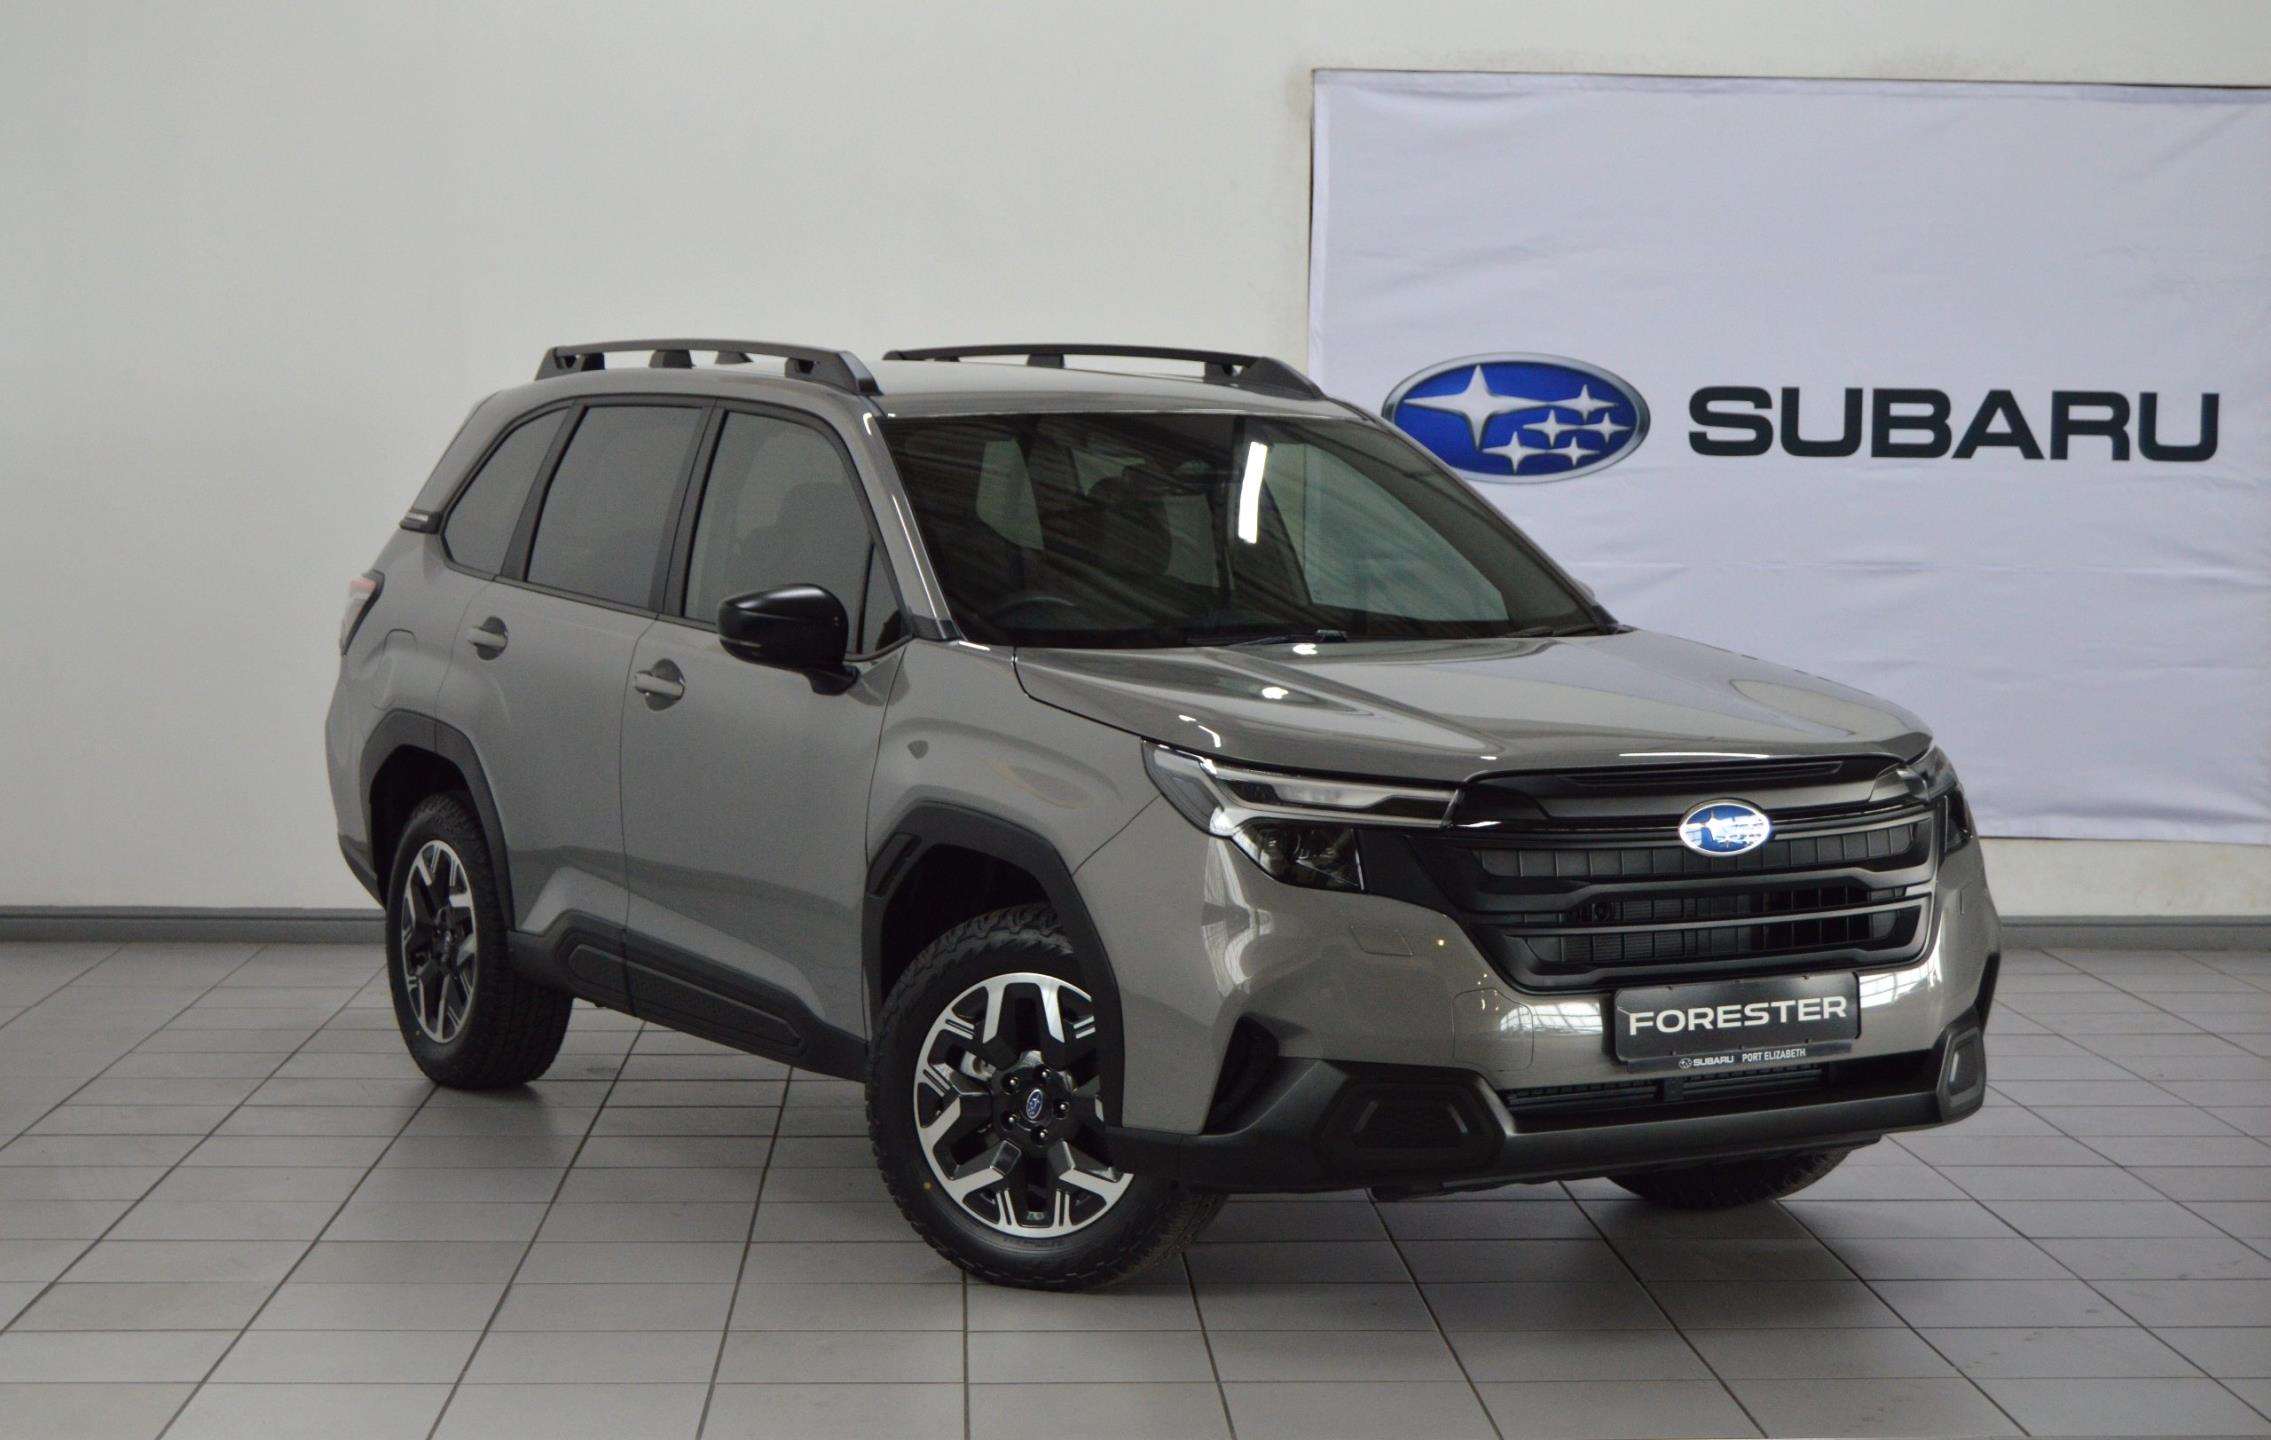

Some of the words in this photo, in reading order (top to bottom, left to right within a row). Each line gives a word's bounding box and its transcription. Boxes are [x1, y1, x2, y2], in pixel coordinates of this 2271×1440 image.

[1689, 386, 2219, 462] SUBARU
[1628, 996, 1847, 1036] FORESTER
[1693, 1055, 1735, 1067] SUBARU
[1742, 1051, 1762, 1063] PORT
[1763, 1048, 1806, 1061] ELIZABETH
